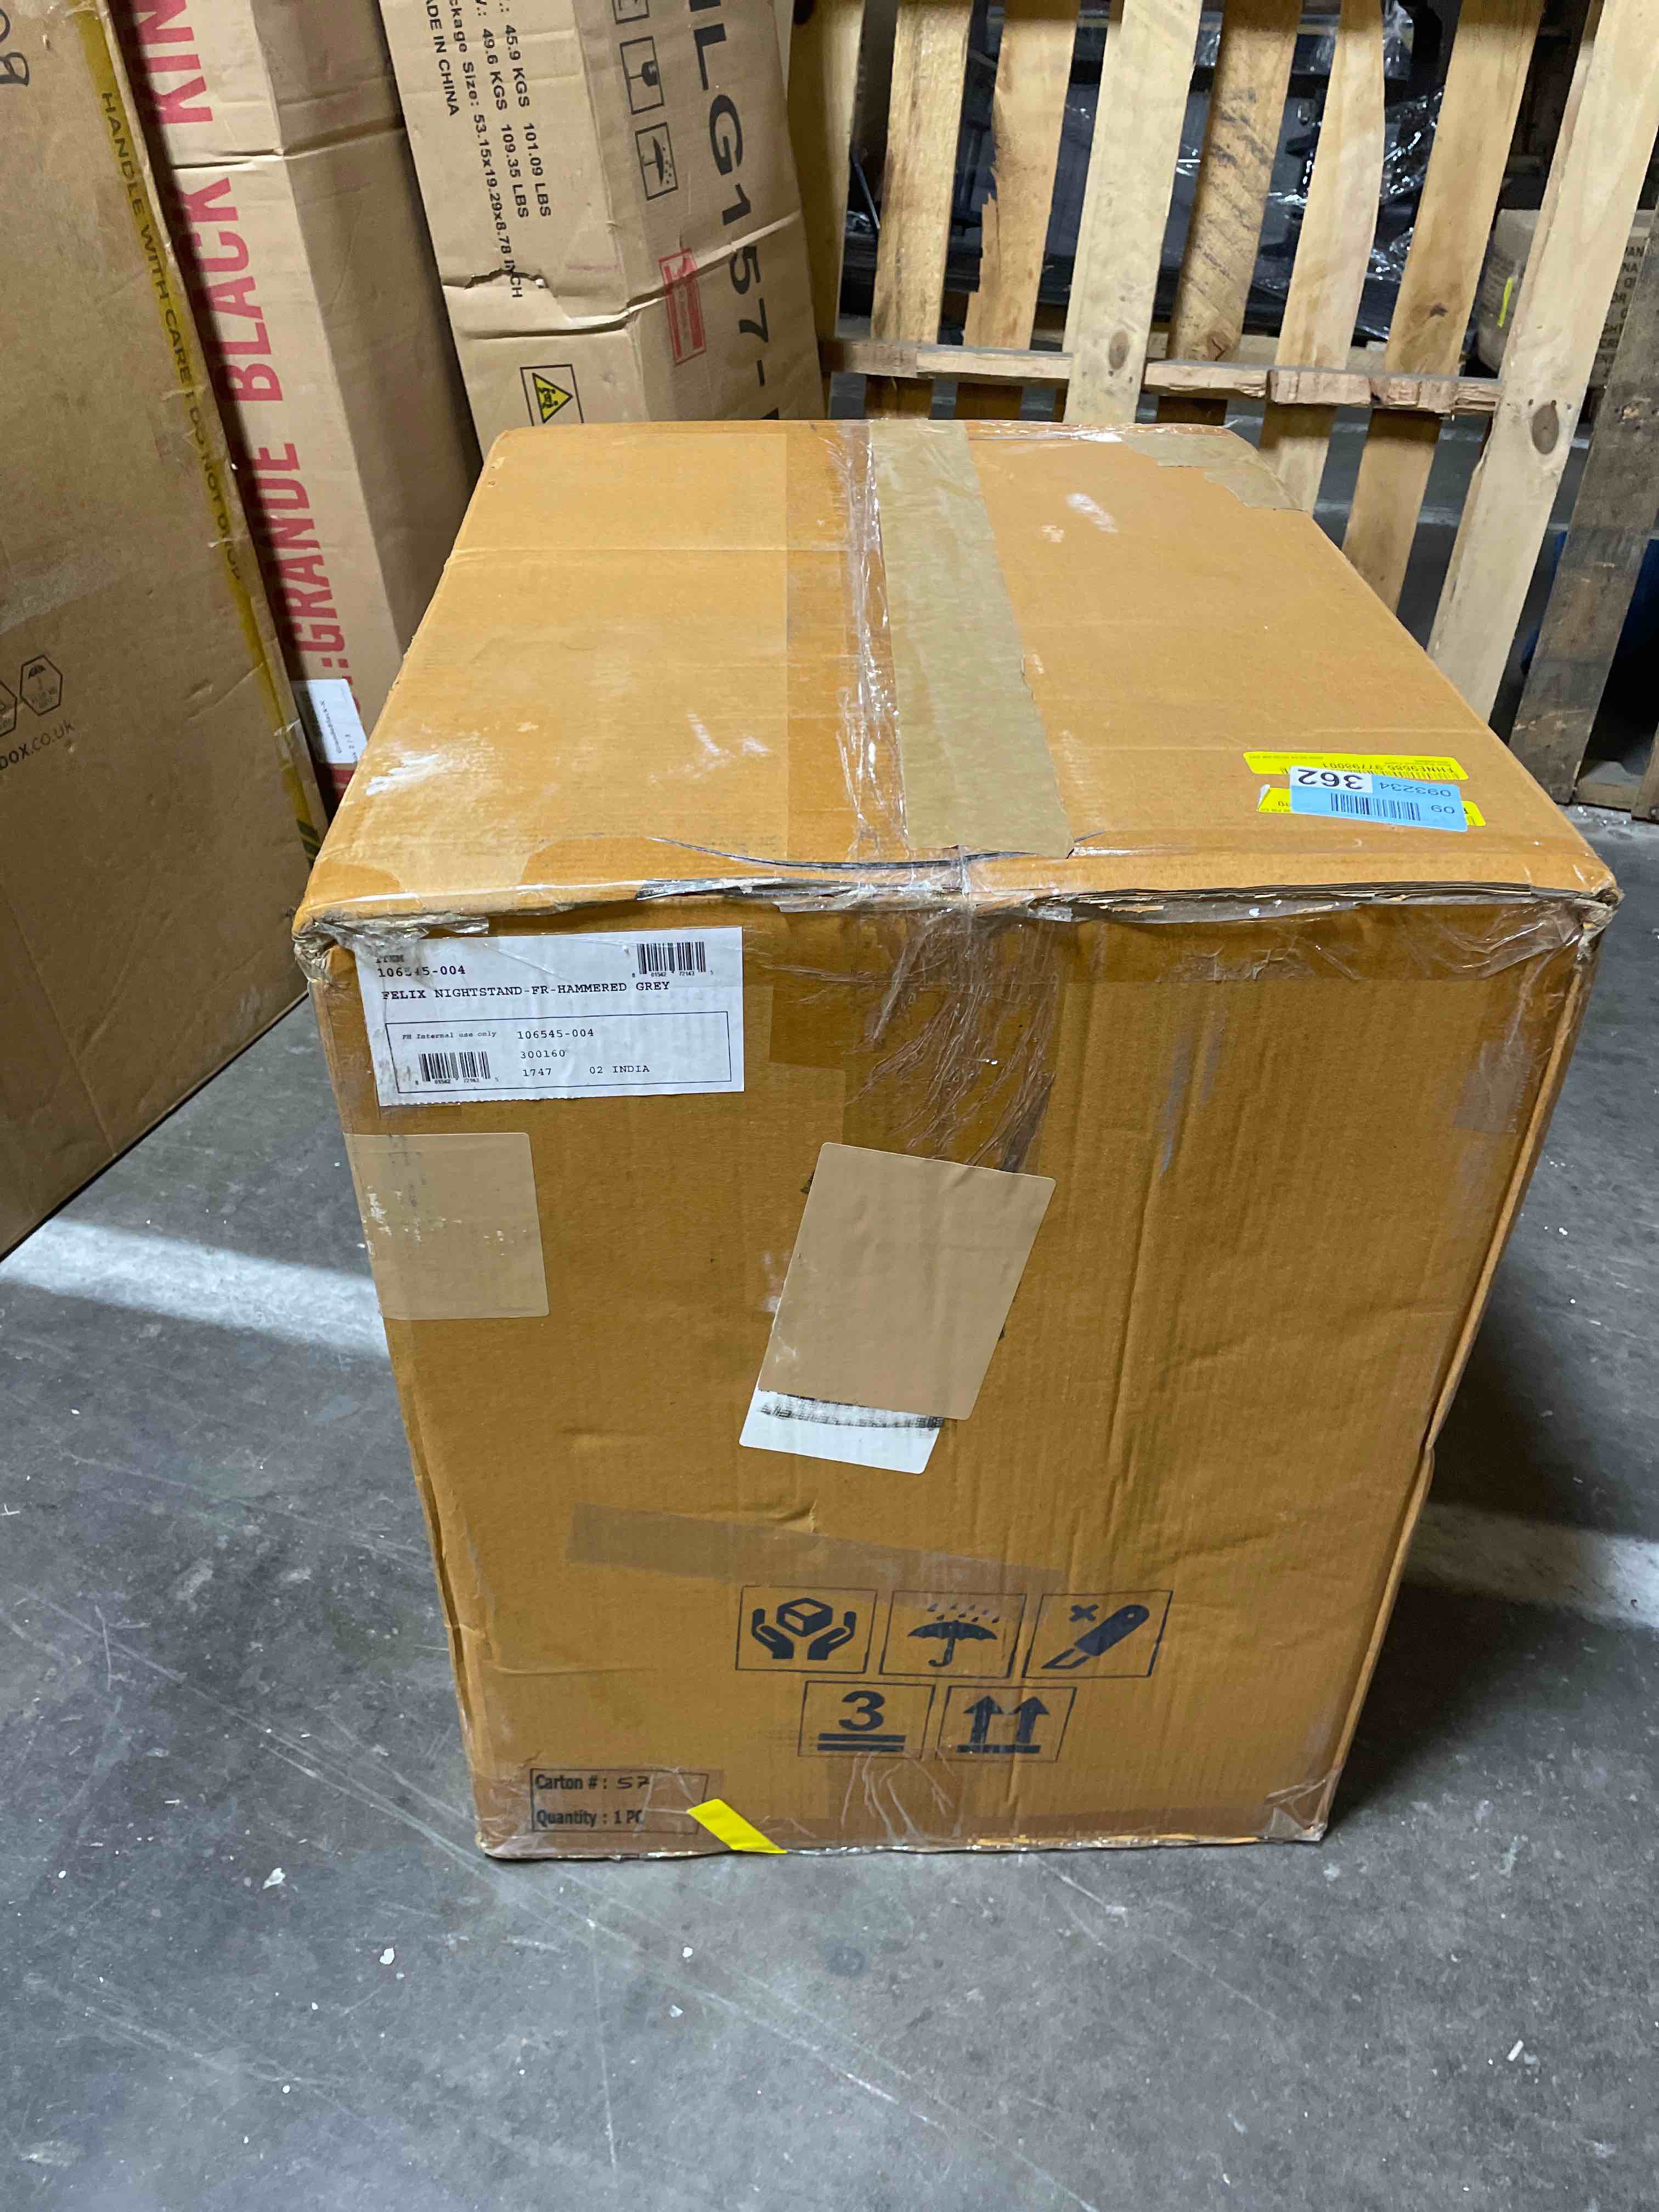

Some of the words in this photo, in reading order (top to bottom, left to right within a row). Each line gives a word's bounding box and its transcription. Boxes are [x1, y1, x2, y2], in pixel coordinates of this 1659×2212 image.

[433, 36, 447, 53] IN
[483, 29, 499, 65] 49.6
[506, 25, 521, 60] 45.9
[439, 59, 460, 116] CHINA
[490, 71, 507, 110] KGS
[512, 67, 530, 108] KGS
[501, 124, 521, 178] 109.35
[523, 123, 544, 176] 101.09
[512, 184, 529, 218] LBS
[535, 183, 551, 217] LBS
[101, 92, 145, 216] HANDLE
[140, 224, 170, 300] WITH
[165, 308, 191, 384] CARE
[182, 177, 284, 402] BLACK
[1297, 768, 1365, 791] 362
[1379, 781, 1452, 798] 093234
[1430, 804, 1455, 815] 09
[382, 990, 427, 1000] FELIX
[635, 981, 670, 992] GREY
[517, 1028, 594, 1040] 106545-004
[520, 1049, 566, 1059] 300160
[523, 1068, 552, 1077] 1747
[589, 1066, 604, 1075] 02
[612, 1065, 651, 1074] INDIA
[838, 1690, 887, 1732] 3
[534, 1773, 583, 1791] Carton
[536, 1809, 598, 1828] Quantity
[613, 1809, 621, 1825] 1
